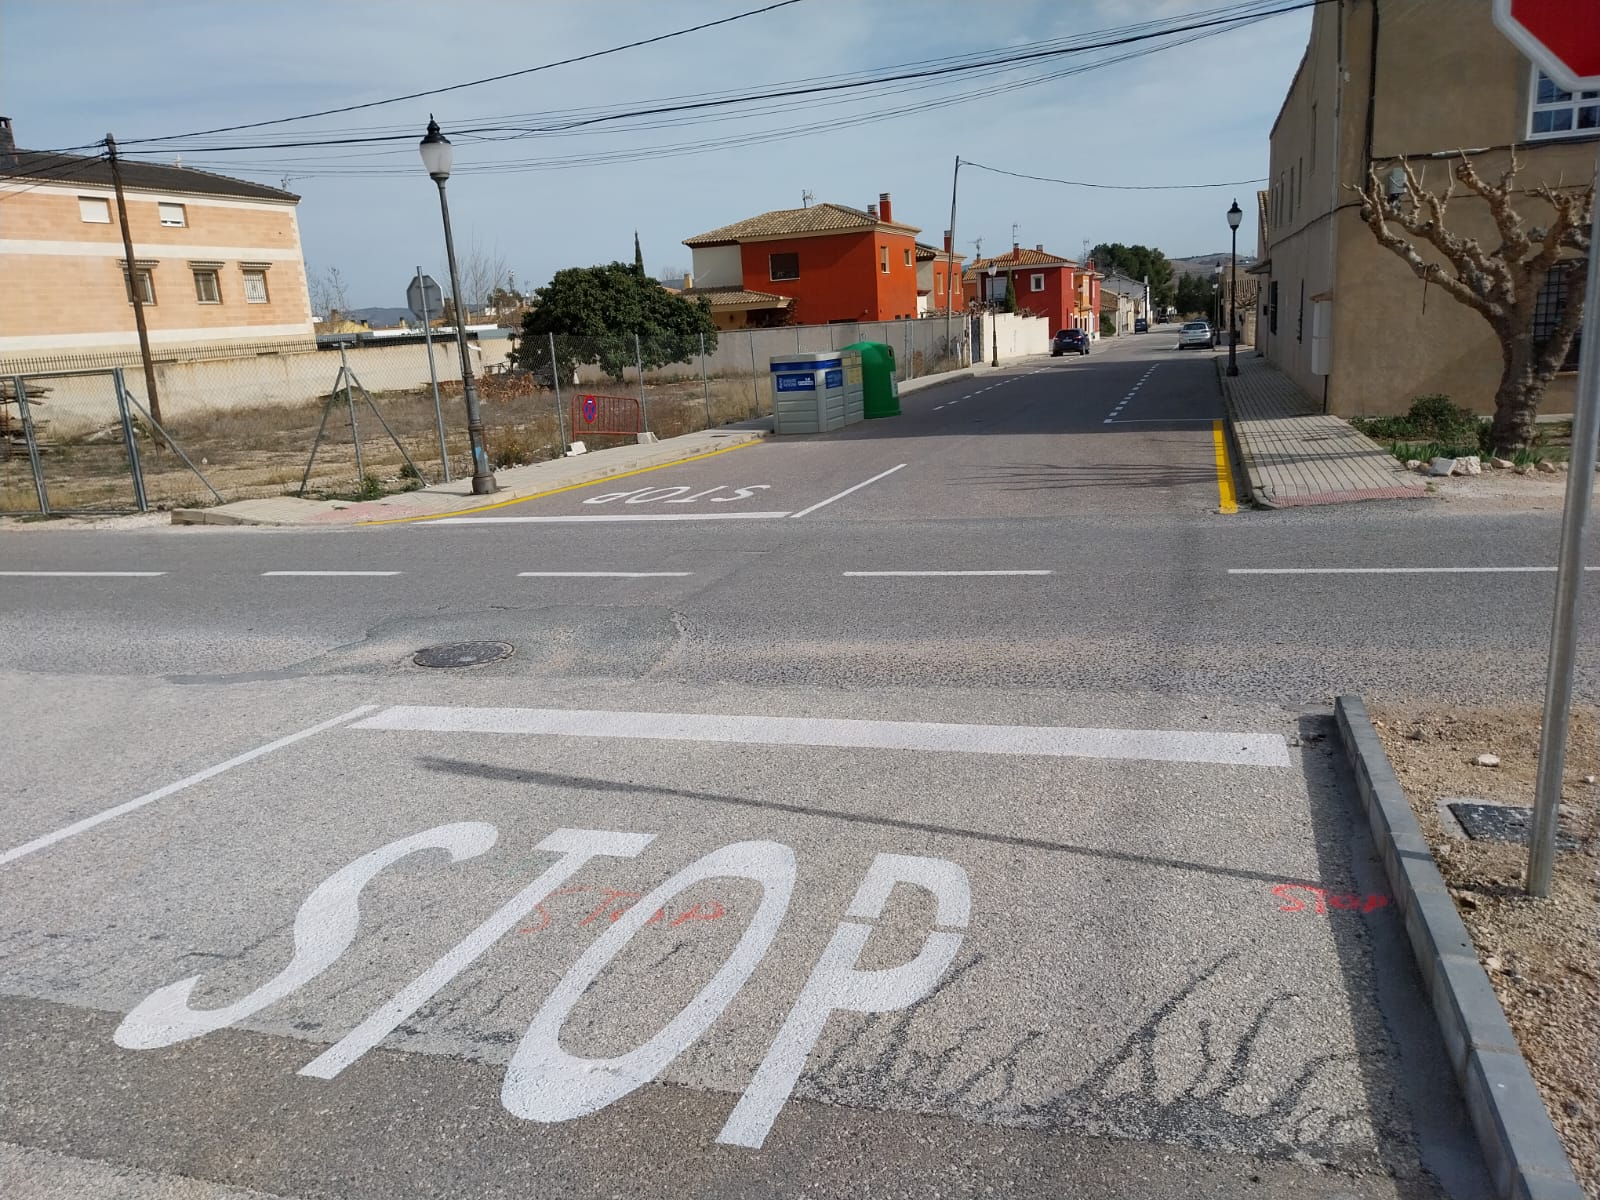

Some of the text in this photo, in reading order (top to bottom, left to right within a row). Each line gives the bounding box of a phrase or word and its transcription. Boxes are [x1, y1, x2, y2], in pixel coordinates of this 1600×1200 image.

[582, 484, 771, 504] STOP
[1271, 883, 1389, 915] STOP
[113, 820, 973, 1150] STOP
